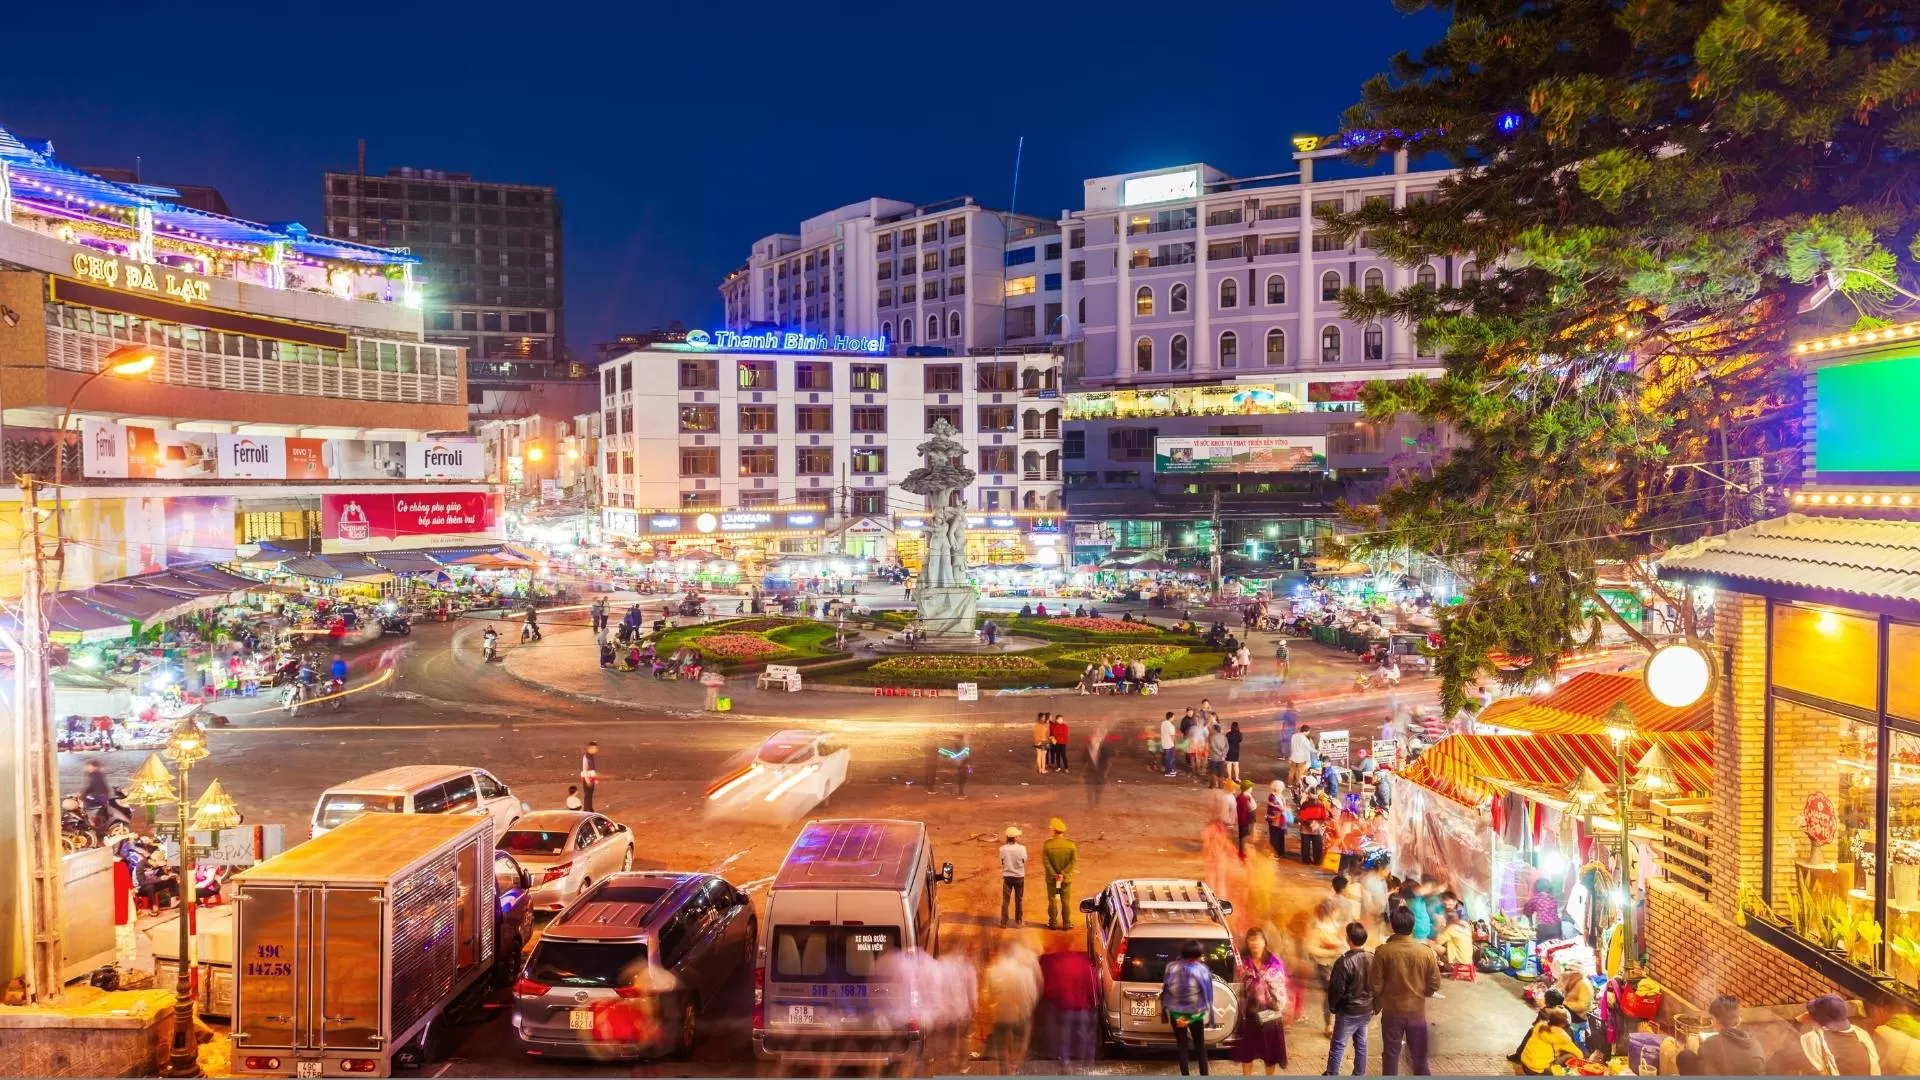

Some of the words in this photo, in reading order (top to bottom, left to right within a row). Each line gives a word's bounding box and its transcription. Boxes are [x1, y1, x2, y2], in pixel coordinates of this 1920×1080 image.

[74, 253, 118, 287] CHỢ
[125, 264, 158, 291] ĐÀ
[165, 274, 210, 303] LẠT
[715, 331, 778, 348] Thanh
[833, 335, 885, 351] Hotel
[96, 432, 116, 461] Ferroli
[233, 443, 268, 466] Ferroli
[424, 450, 463, 468] Ferroli
[257, 944, 283, 958] 49C
[248, 962, 292, 976] 147.58
[812, 985, 827, 996] 51B
[840, 985, 867, 996] 168.79
[794, 1006, 808, 1014] 51B
[303, 1062, 317, 1071] 49C
